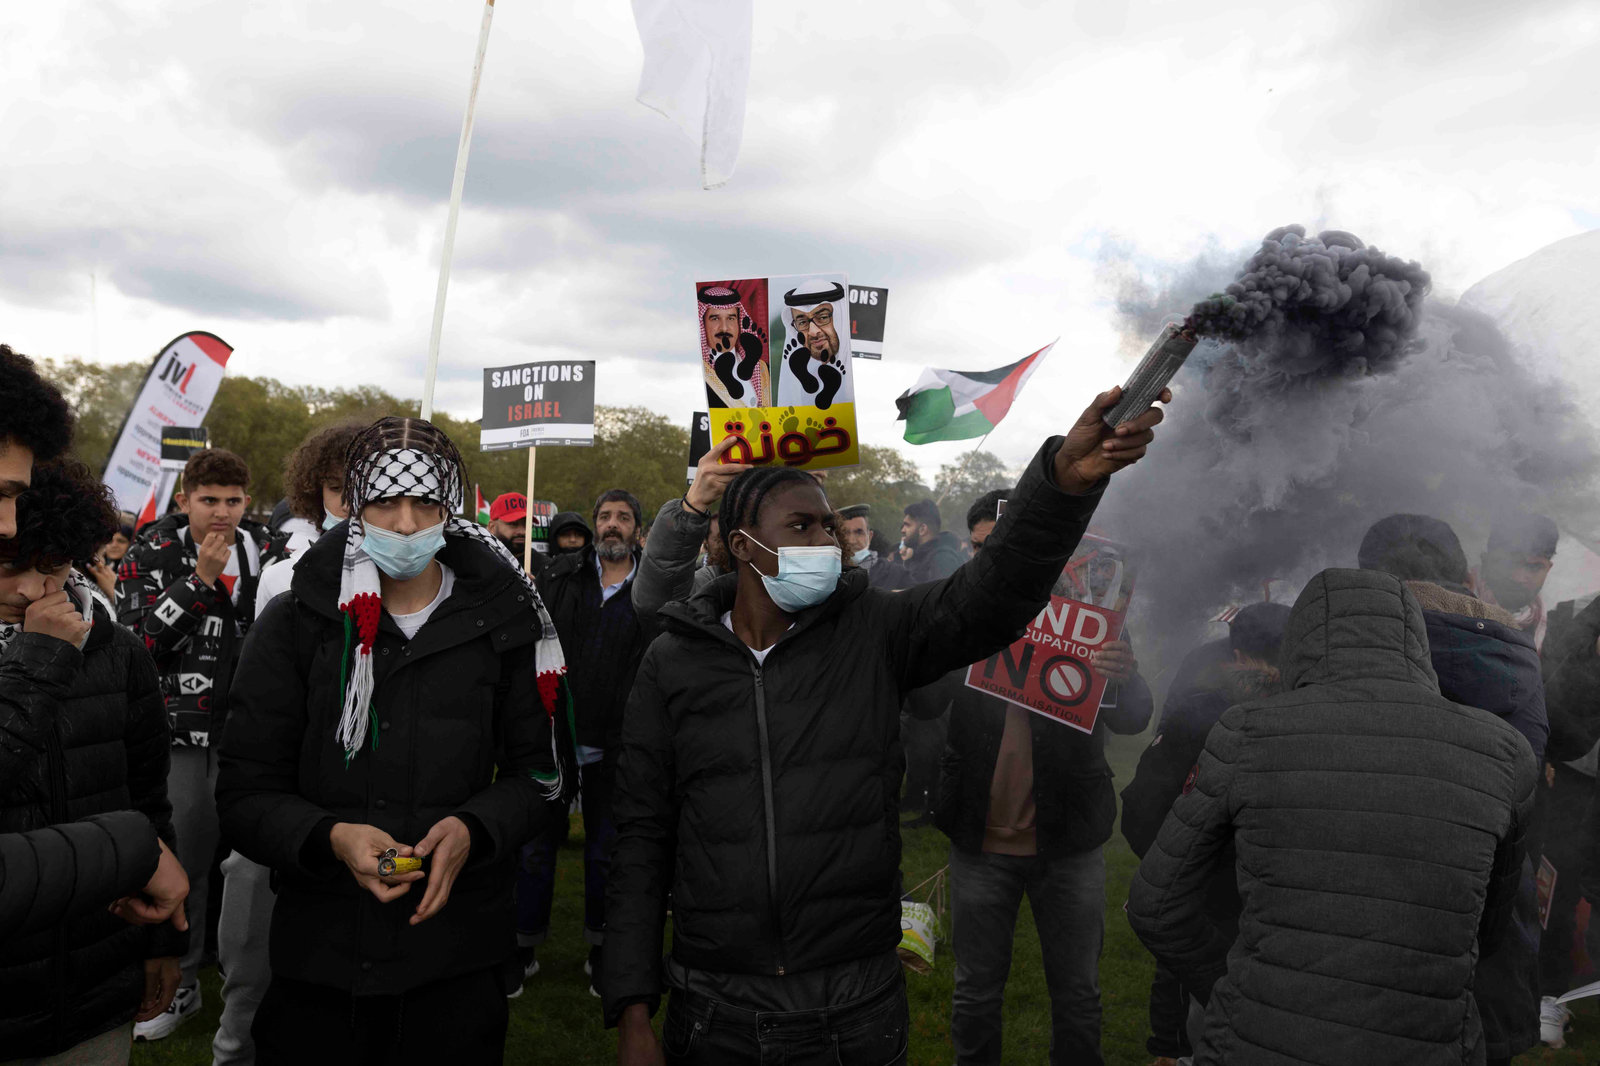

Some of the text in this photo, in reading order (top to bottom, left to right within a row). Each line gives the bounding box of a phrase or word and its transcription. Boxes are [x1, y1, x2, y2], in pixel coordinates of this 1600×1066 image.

[492, 365, 583, 388] SANCTIONS
[524, 384, 543, 401] ON
[508, 401, 561, 422] ISRAEL
[505, 498, 527, 511] ICO
[1034, 600, 1108, 645] ND
[1023, 627, 1097, 663] CUPATION
[981, 680, 1083, 724] NORMALISATION
